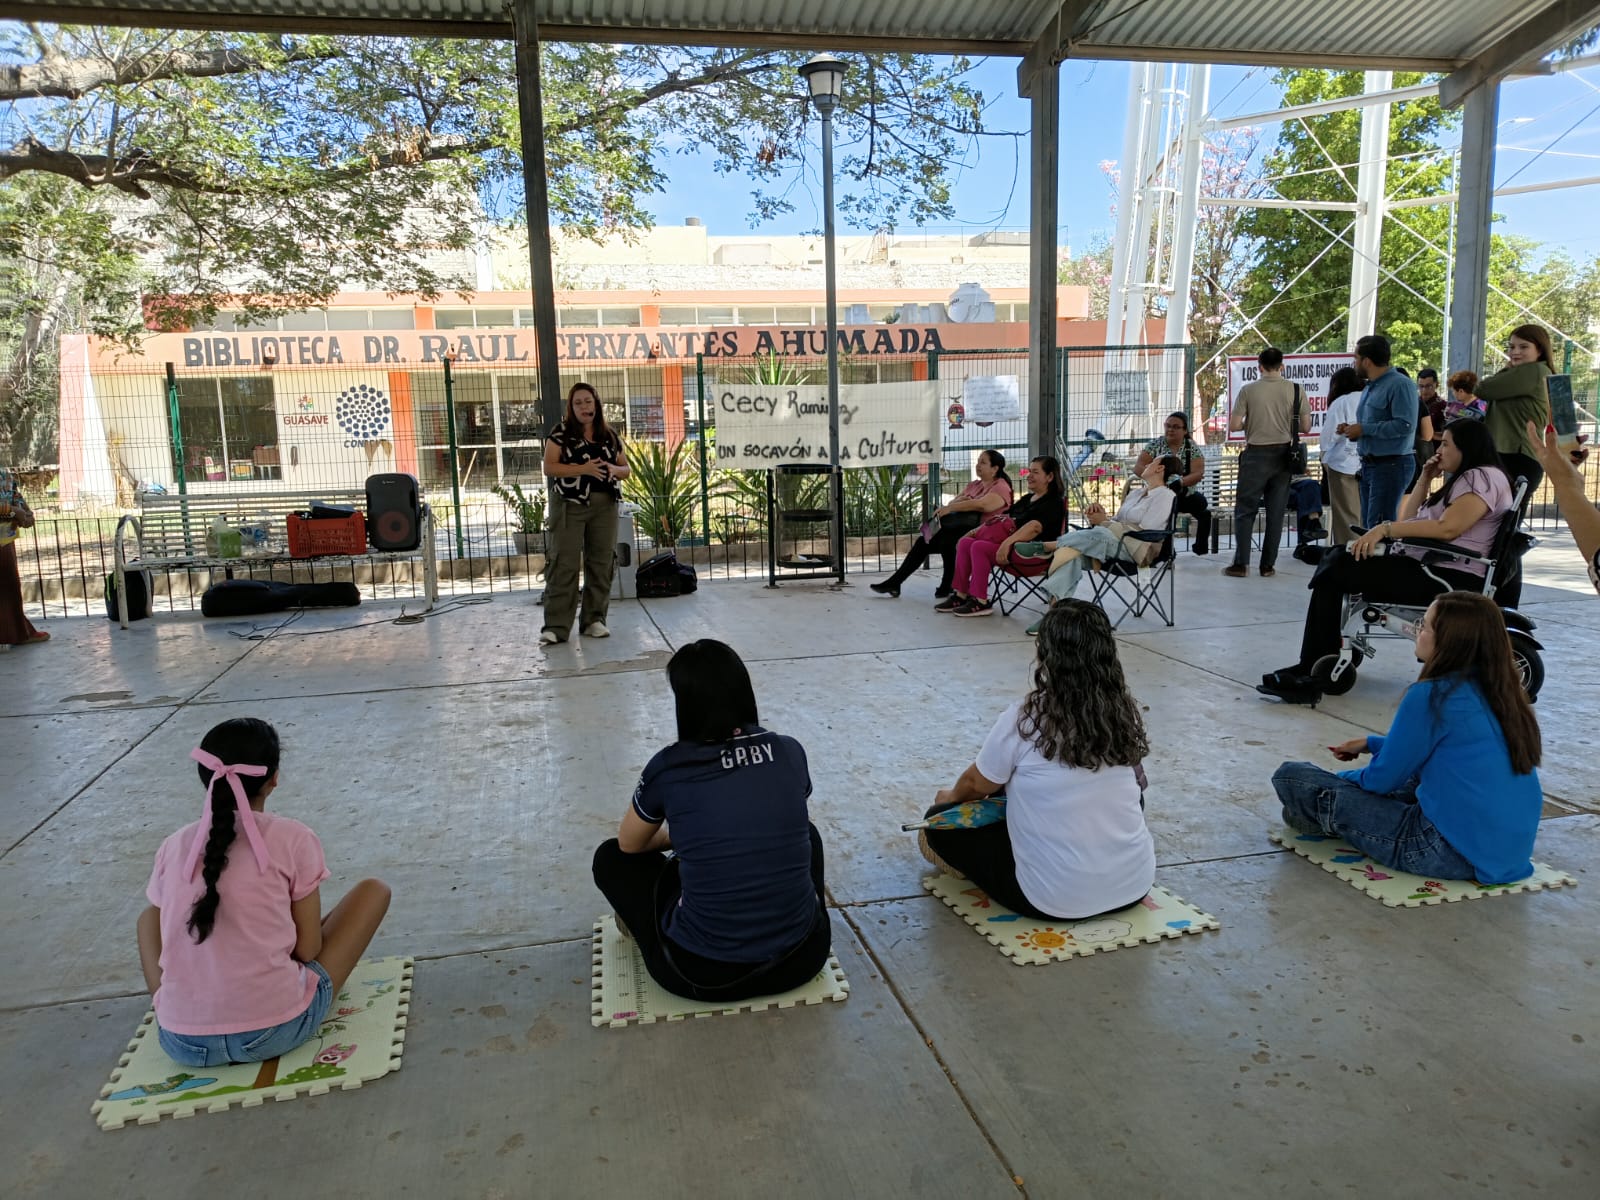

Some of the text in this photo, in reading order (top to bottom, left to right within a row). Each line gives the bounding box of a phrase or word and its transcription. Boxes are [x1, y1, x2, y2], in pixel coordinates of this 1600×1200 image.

[183, 335, 344, 367] BIBLIOTECA
[363, 335, 407, 363] DR.
[419, 334, 530, 363] RAUL
[752, 327, 946, 356] AHUMADA
[1242, 366, 1258, 382] LOS
[721, 391, 778, 416] Cecy
[283, 414, 329, 426] GUASAVE
[718, 430, 933, 461] UN SOCAVÓN A A Cultura
[720, 743, 775, 769] GABY
